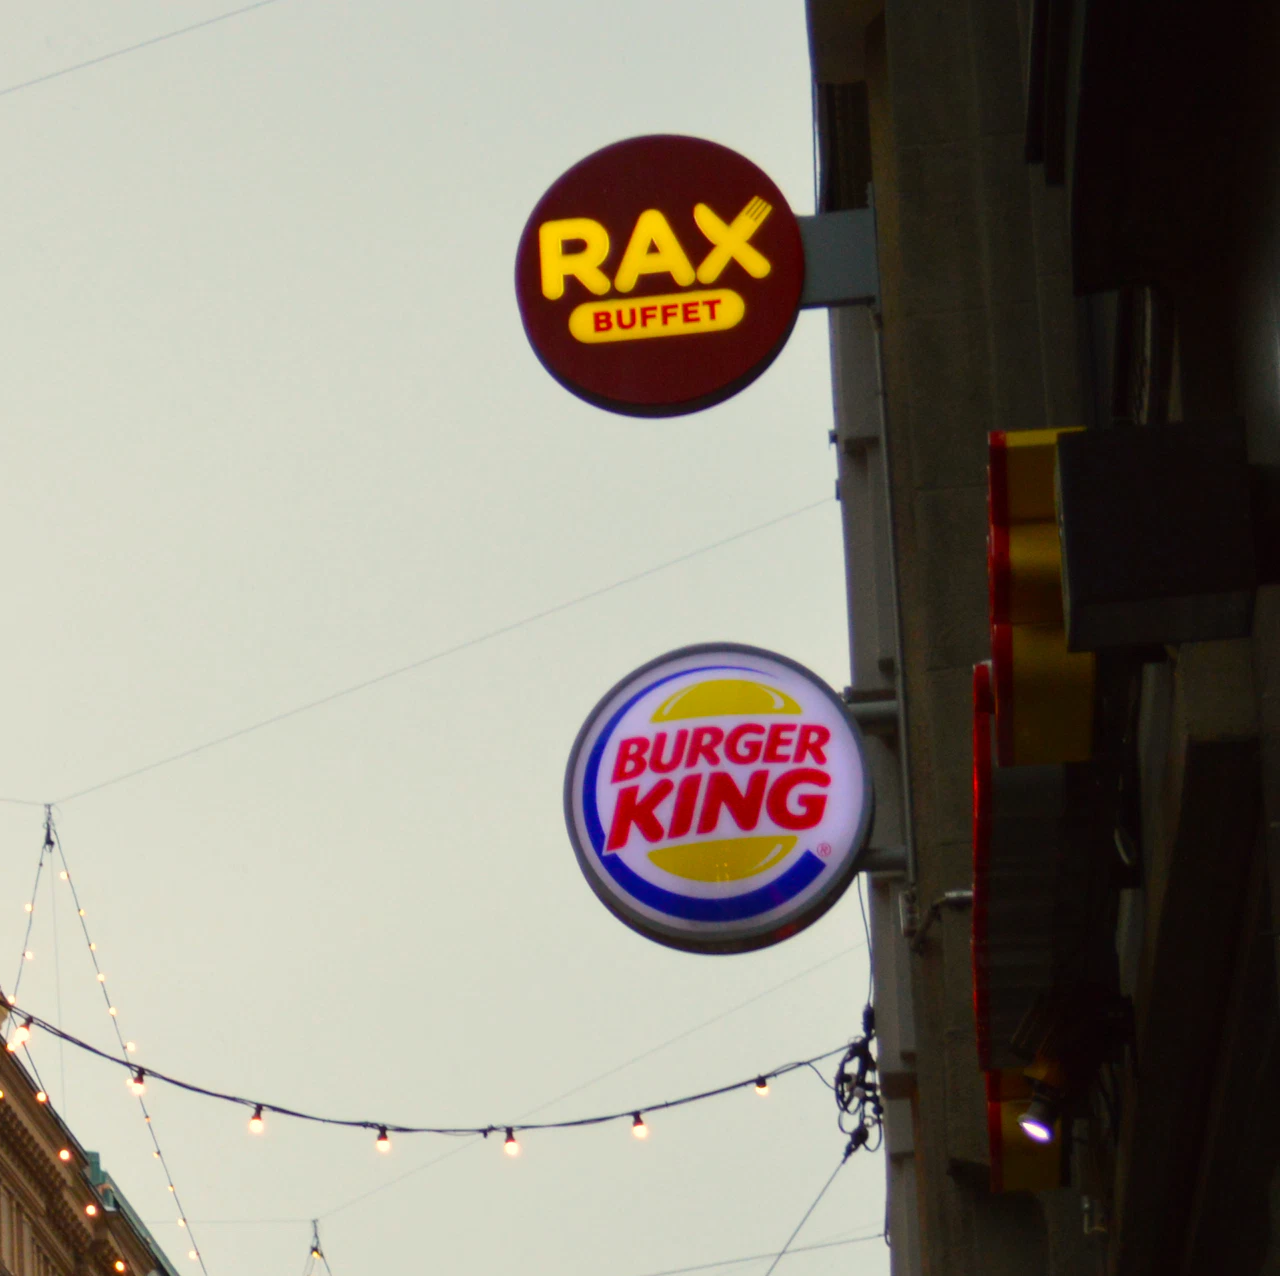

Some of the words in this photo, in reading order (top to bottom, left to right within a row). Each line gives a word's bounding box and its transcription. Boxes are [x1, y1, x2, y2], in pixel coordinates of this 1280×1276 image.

[538, 195, 773, 300] RAX
[592, 299, 722, 333] BUFFET
[610, 722, 831, 784] BURGER
[606, 767, 832, 852] KING
